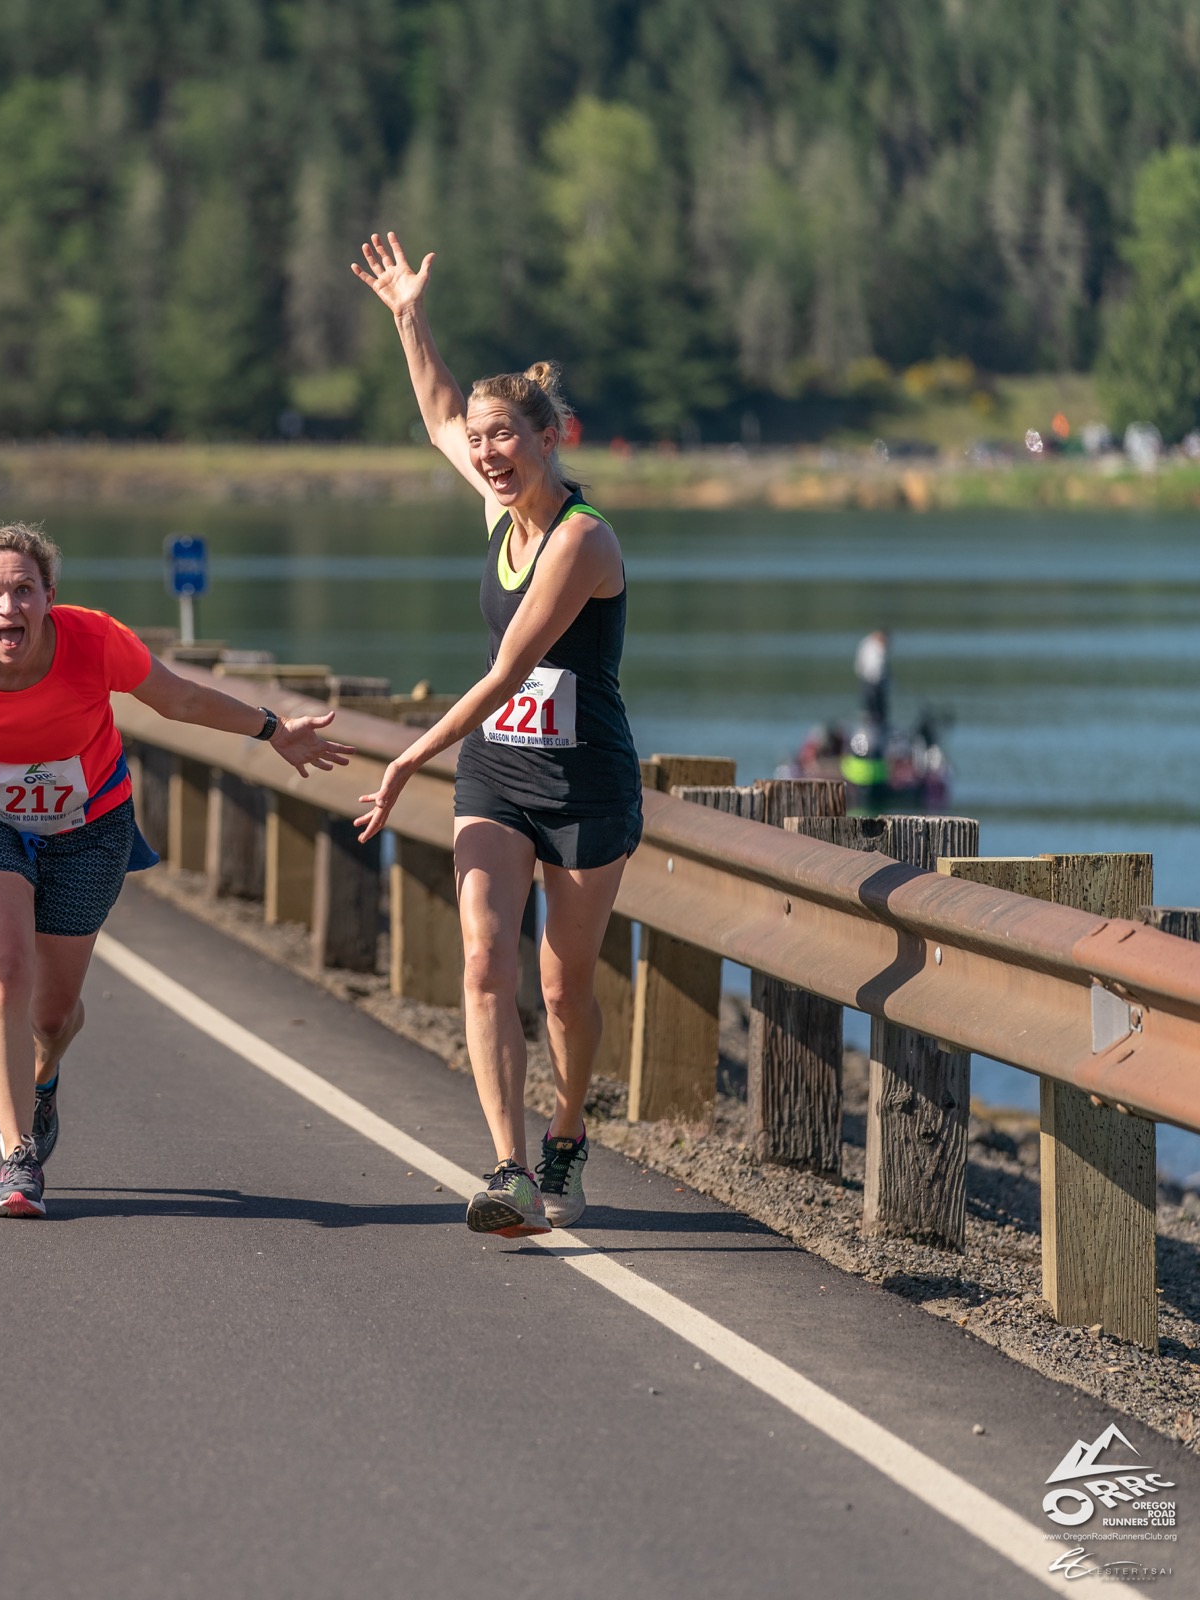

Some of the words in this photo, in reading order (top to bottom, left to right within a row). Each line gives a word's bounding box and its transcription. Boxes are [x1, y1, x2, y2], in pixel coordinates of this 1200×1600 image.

[495, 696, 559, 735] 221
[489, 732, 509, 742] OREGON
[511, 735, 525, 744] ROAD
[527, 736, 553, 746] RUNNERS
[555, 738, 569, 746] CLUB
[5, 785, 74, 813] 217
